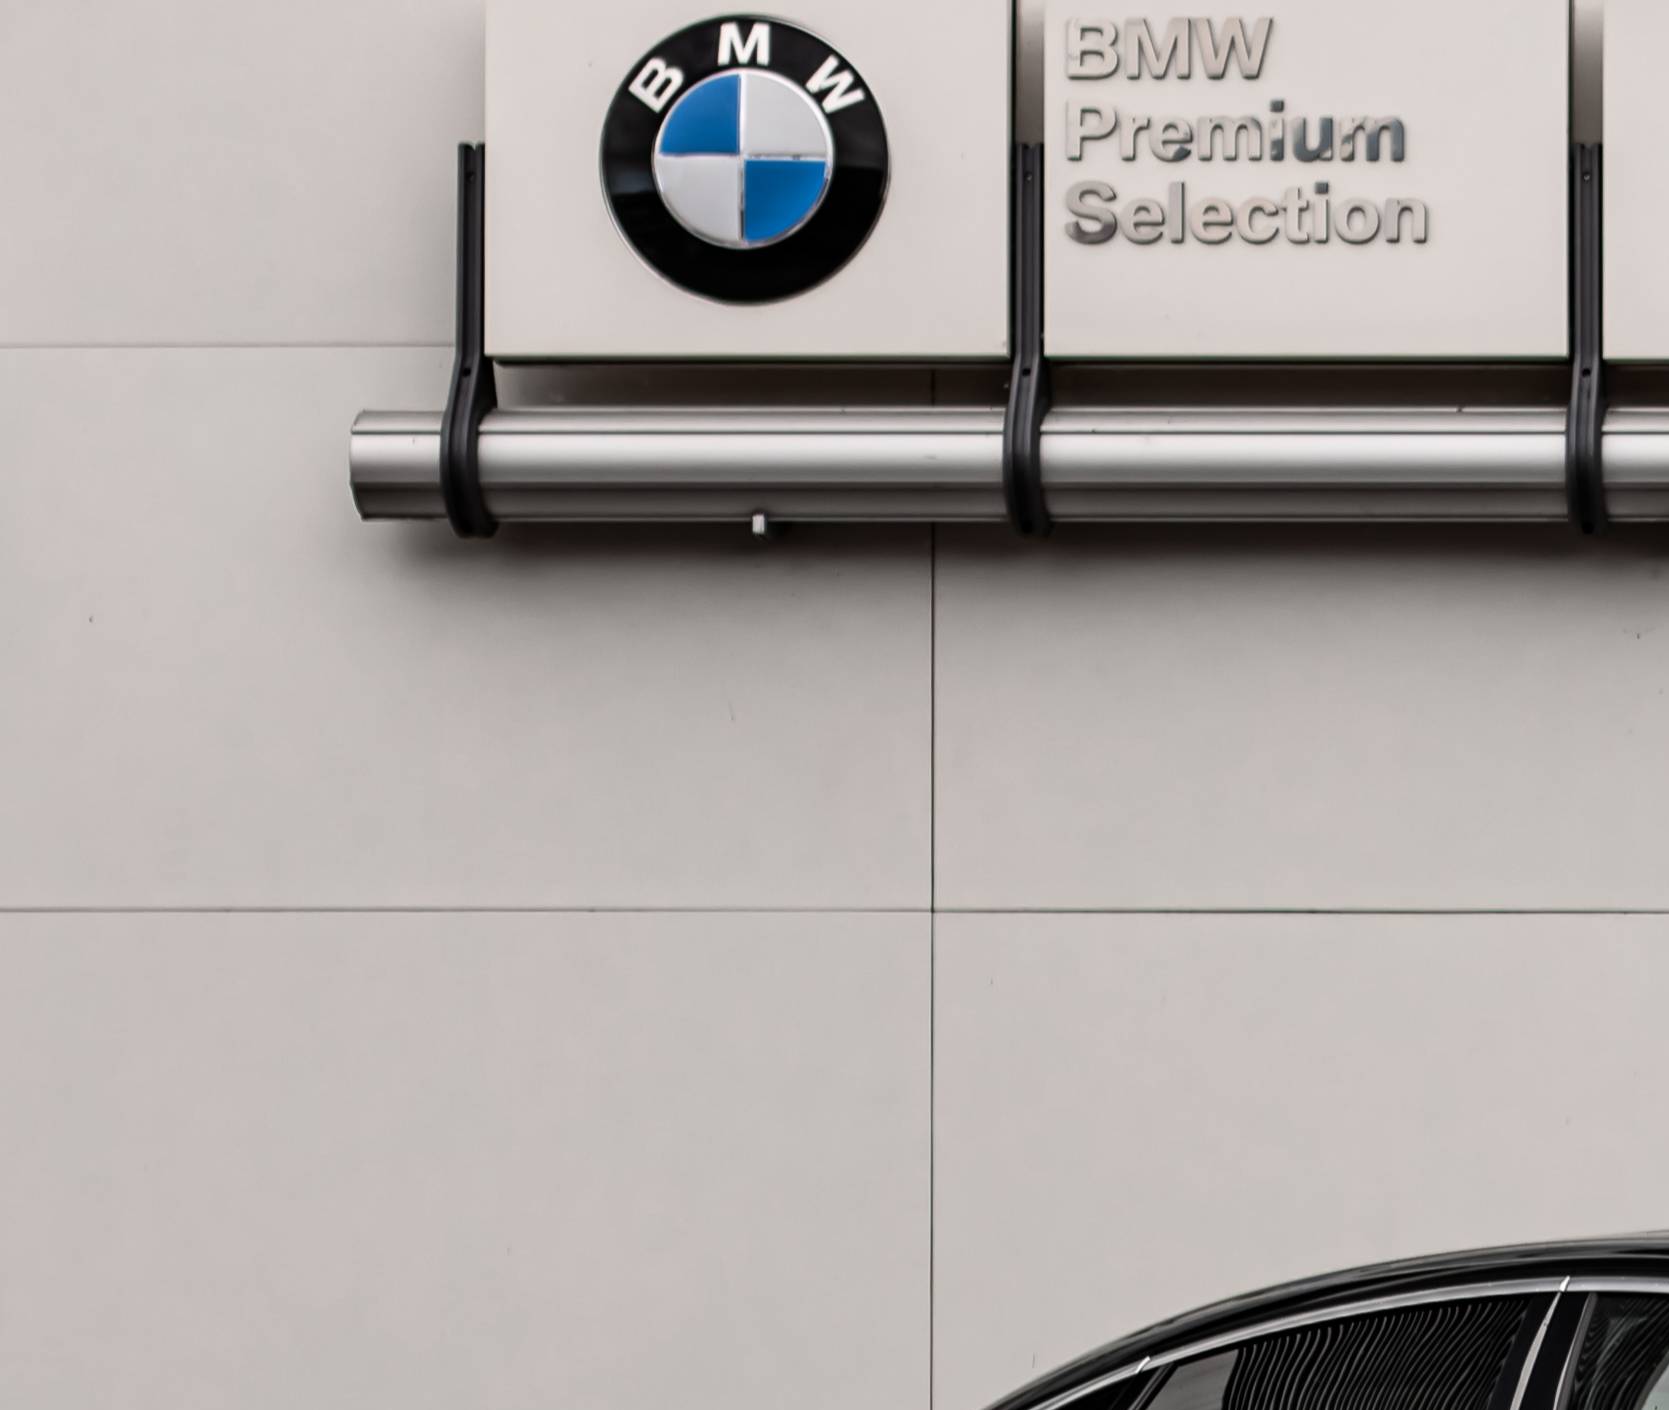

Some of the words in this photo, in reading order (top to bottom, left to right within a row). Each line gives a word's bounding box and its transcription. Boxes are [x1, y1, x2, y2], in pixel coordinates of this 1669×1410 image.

[629, 20, 865, 114] BMW
[1064, 15, 1274, 82] BMW
[1064, 98, 1407, 164] Premium
[1062, 181, 1431, 247] Selection
